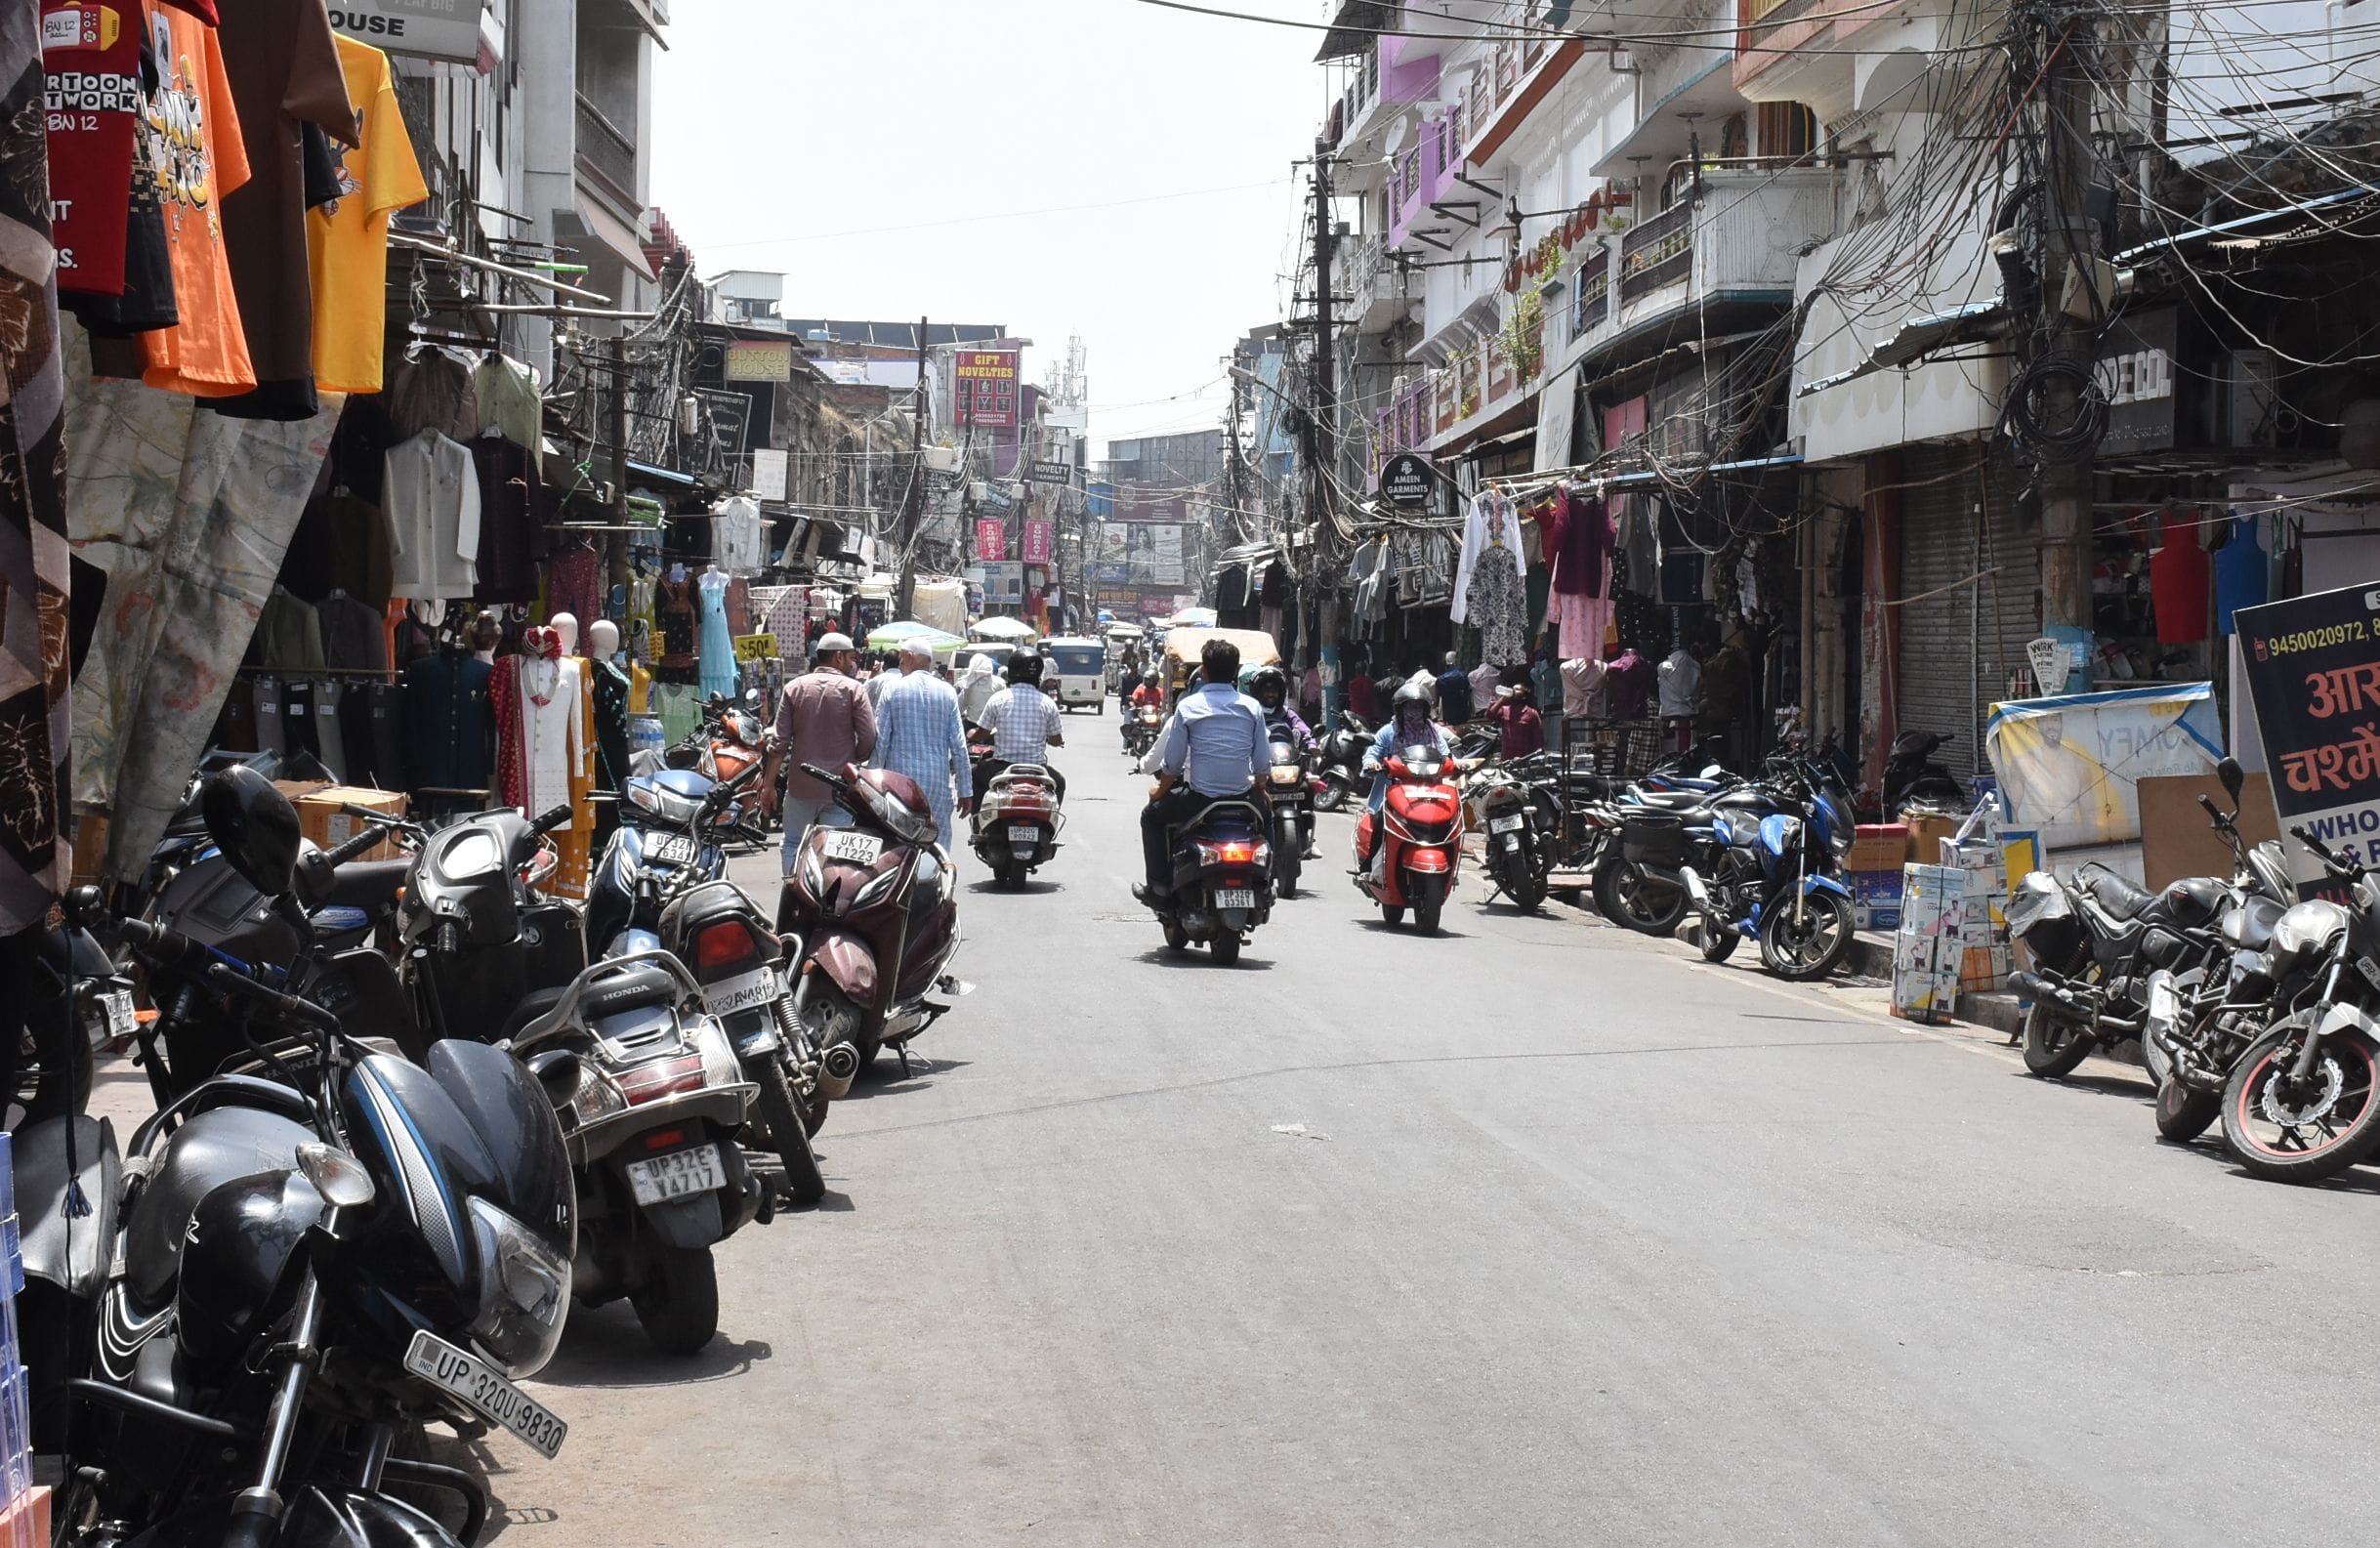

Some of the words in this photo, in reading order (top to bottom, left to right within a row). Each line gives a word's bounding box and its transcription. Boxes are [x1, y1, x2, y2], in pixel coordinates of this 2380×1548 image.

[80, 116, 99, 131] 12
[728, 350, 788, 362] BUTTON
[975, 355, 1000, 365] GIFT
[733, 361, 784, 375] HOUSE
[958, 366, 1013, 378] NOVELTIES
[1035, 464, 1068, 475] NOVELTY
[1394, 475, 1420, 483] AMEEN
[1387, 484, 1429, 494] GARMENTS
[985, 523, 996, 560] BOMBAY
[1032, 524, 1042, 555] BOMBAY
[841, 835, 872, 849] UK17
[836, 844, 873, 861] Y1223
[603, 984, 650, 1001] HONDA
[419, 1360, 433, 1373] IND
[437, 1352, 470, 1385] UP
[518, 1404, 563, 1451] 9830
